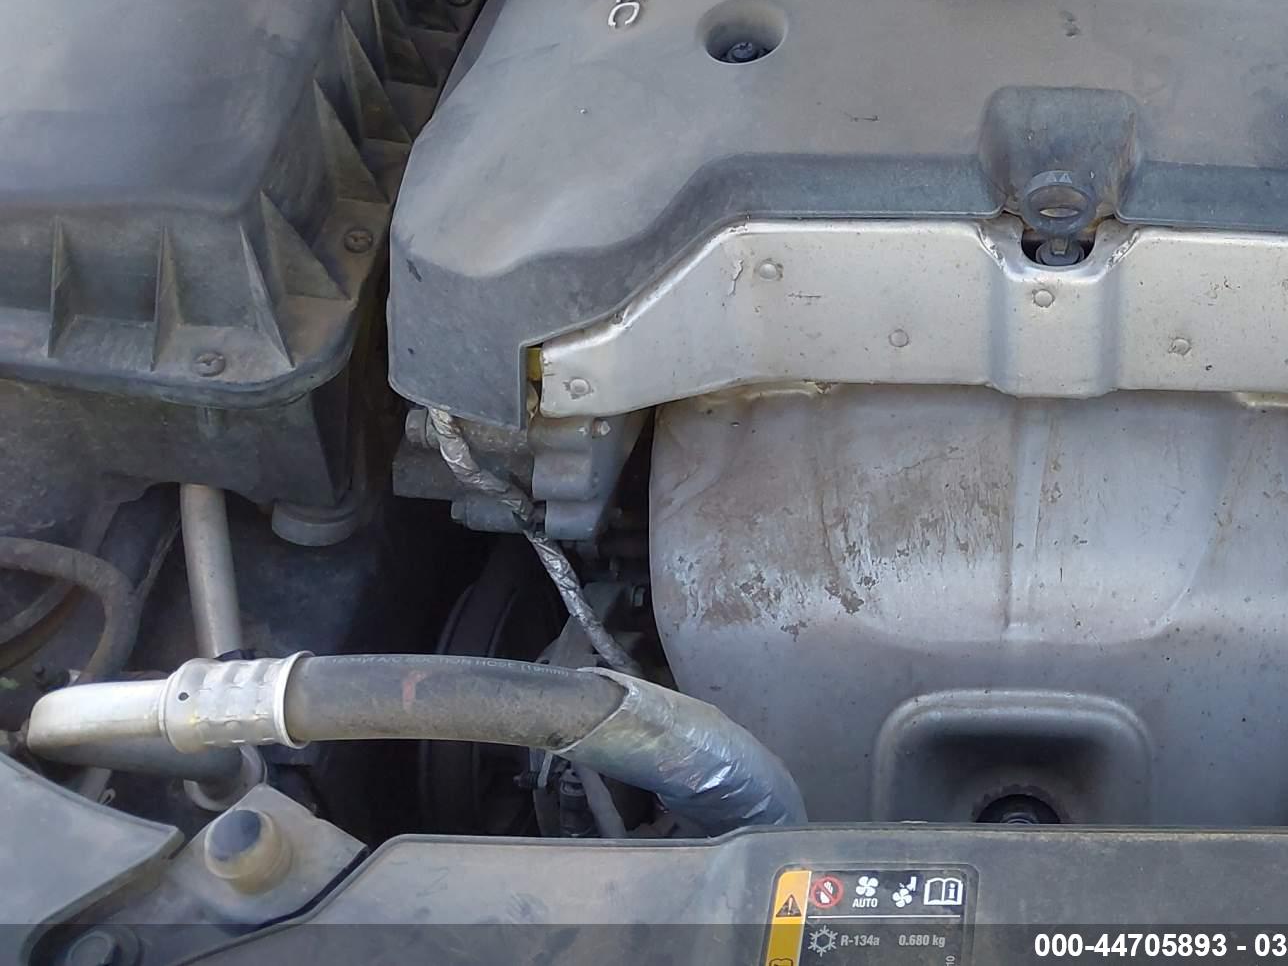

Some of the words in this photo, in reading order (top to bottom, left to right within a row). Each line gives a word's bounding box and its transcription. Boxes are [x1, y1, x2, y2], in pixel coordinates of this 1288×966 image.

[852, 898, 878, 908] AUTO
[840, 936, 880, 947] R-134a
[898, 935, 930, 946] 0.680
[932, 935, 946, 948] kg
